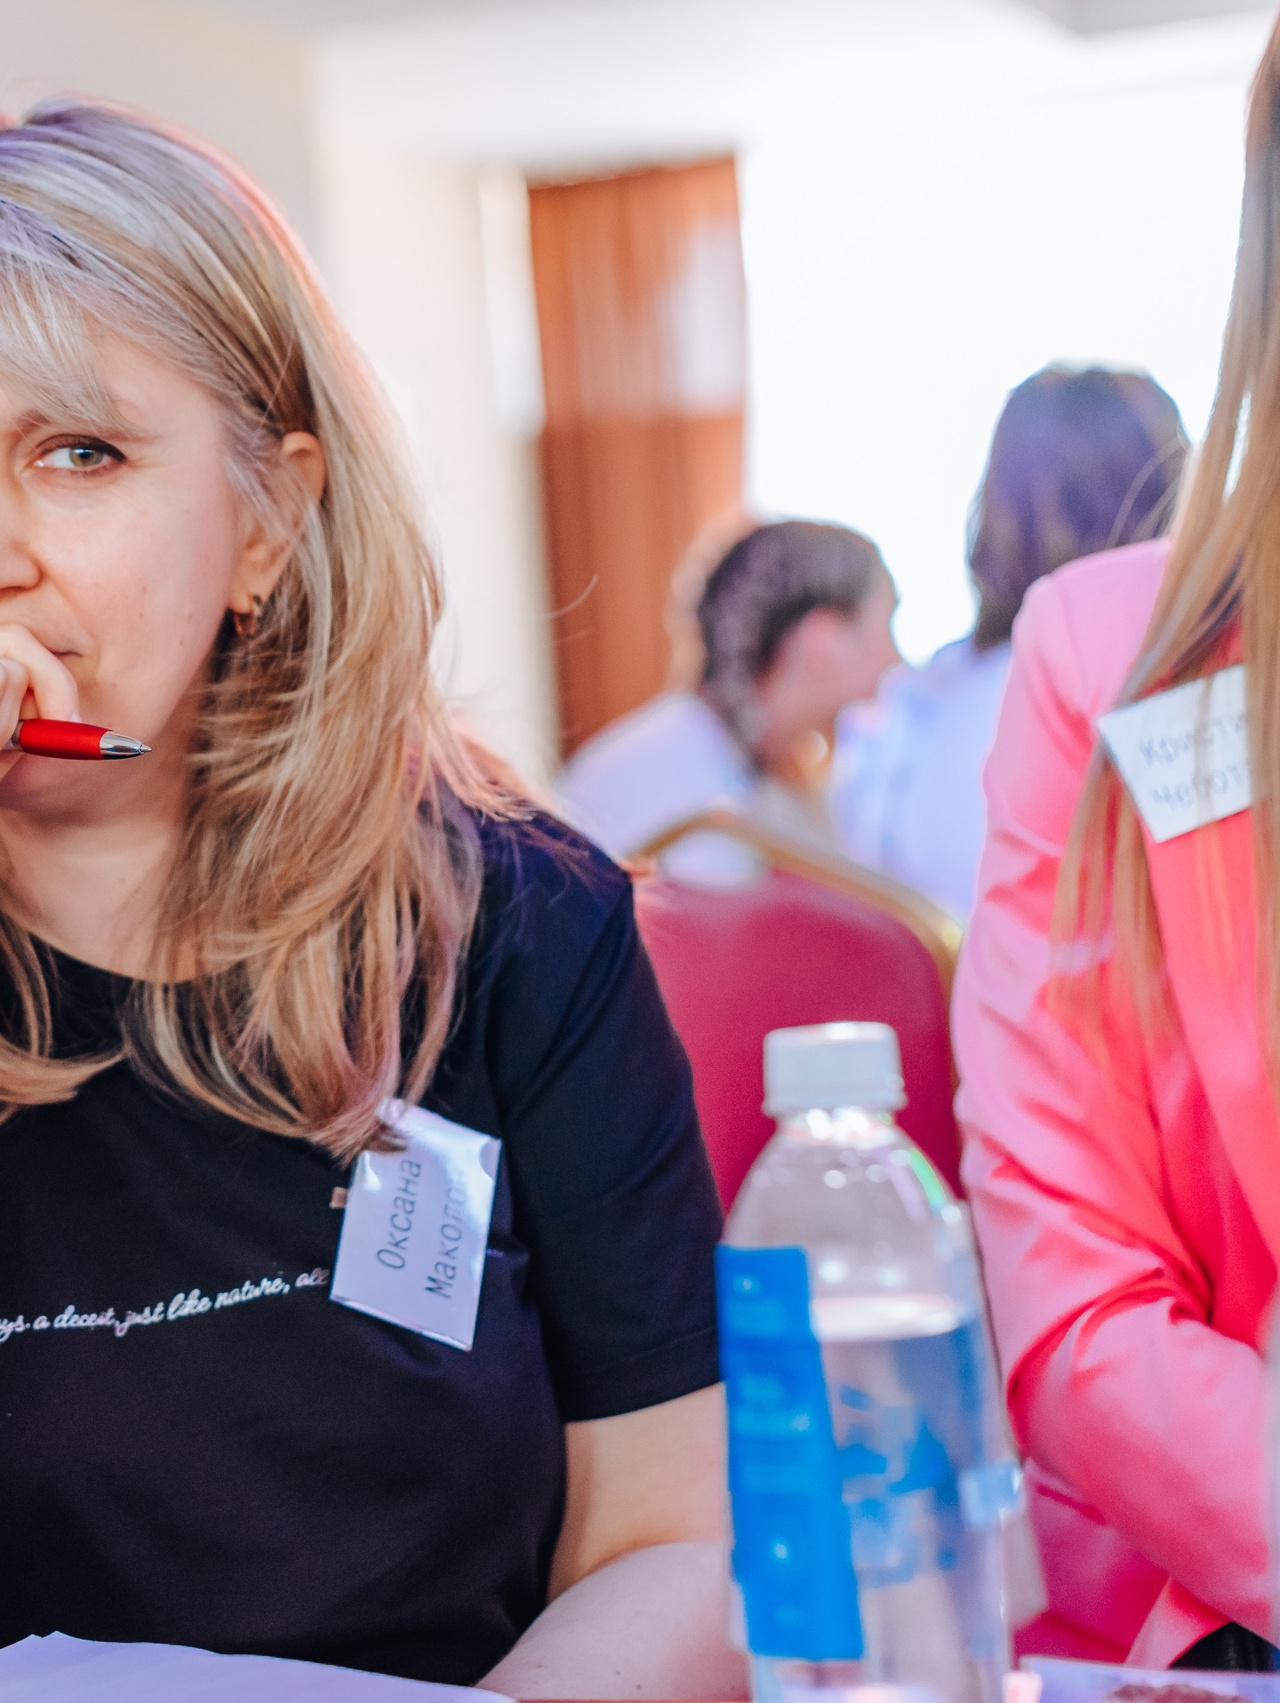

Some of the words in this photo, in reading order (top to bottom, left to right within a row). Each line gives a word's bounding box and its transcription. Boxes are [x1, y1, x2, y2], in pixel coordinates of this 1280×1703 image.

[376, 1158, 421, 1270] Оксана
[425, 1186, 468, 1299] Макого
[32, 1316, 51, 1330] a
[113, 1302, 165, 1337] just
[166, 1288, 213, 1321] like
